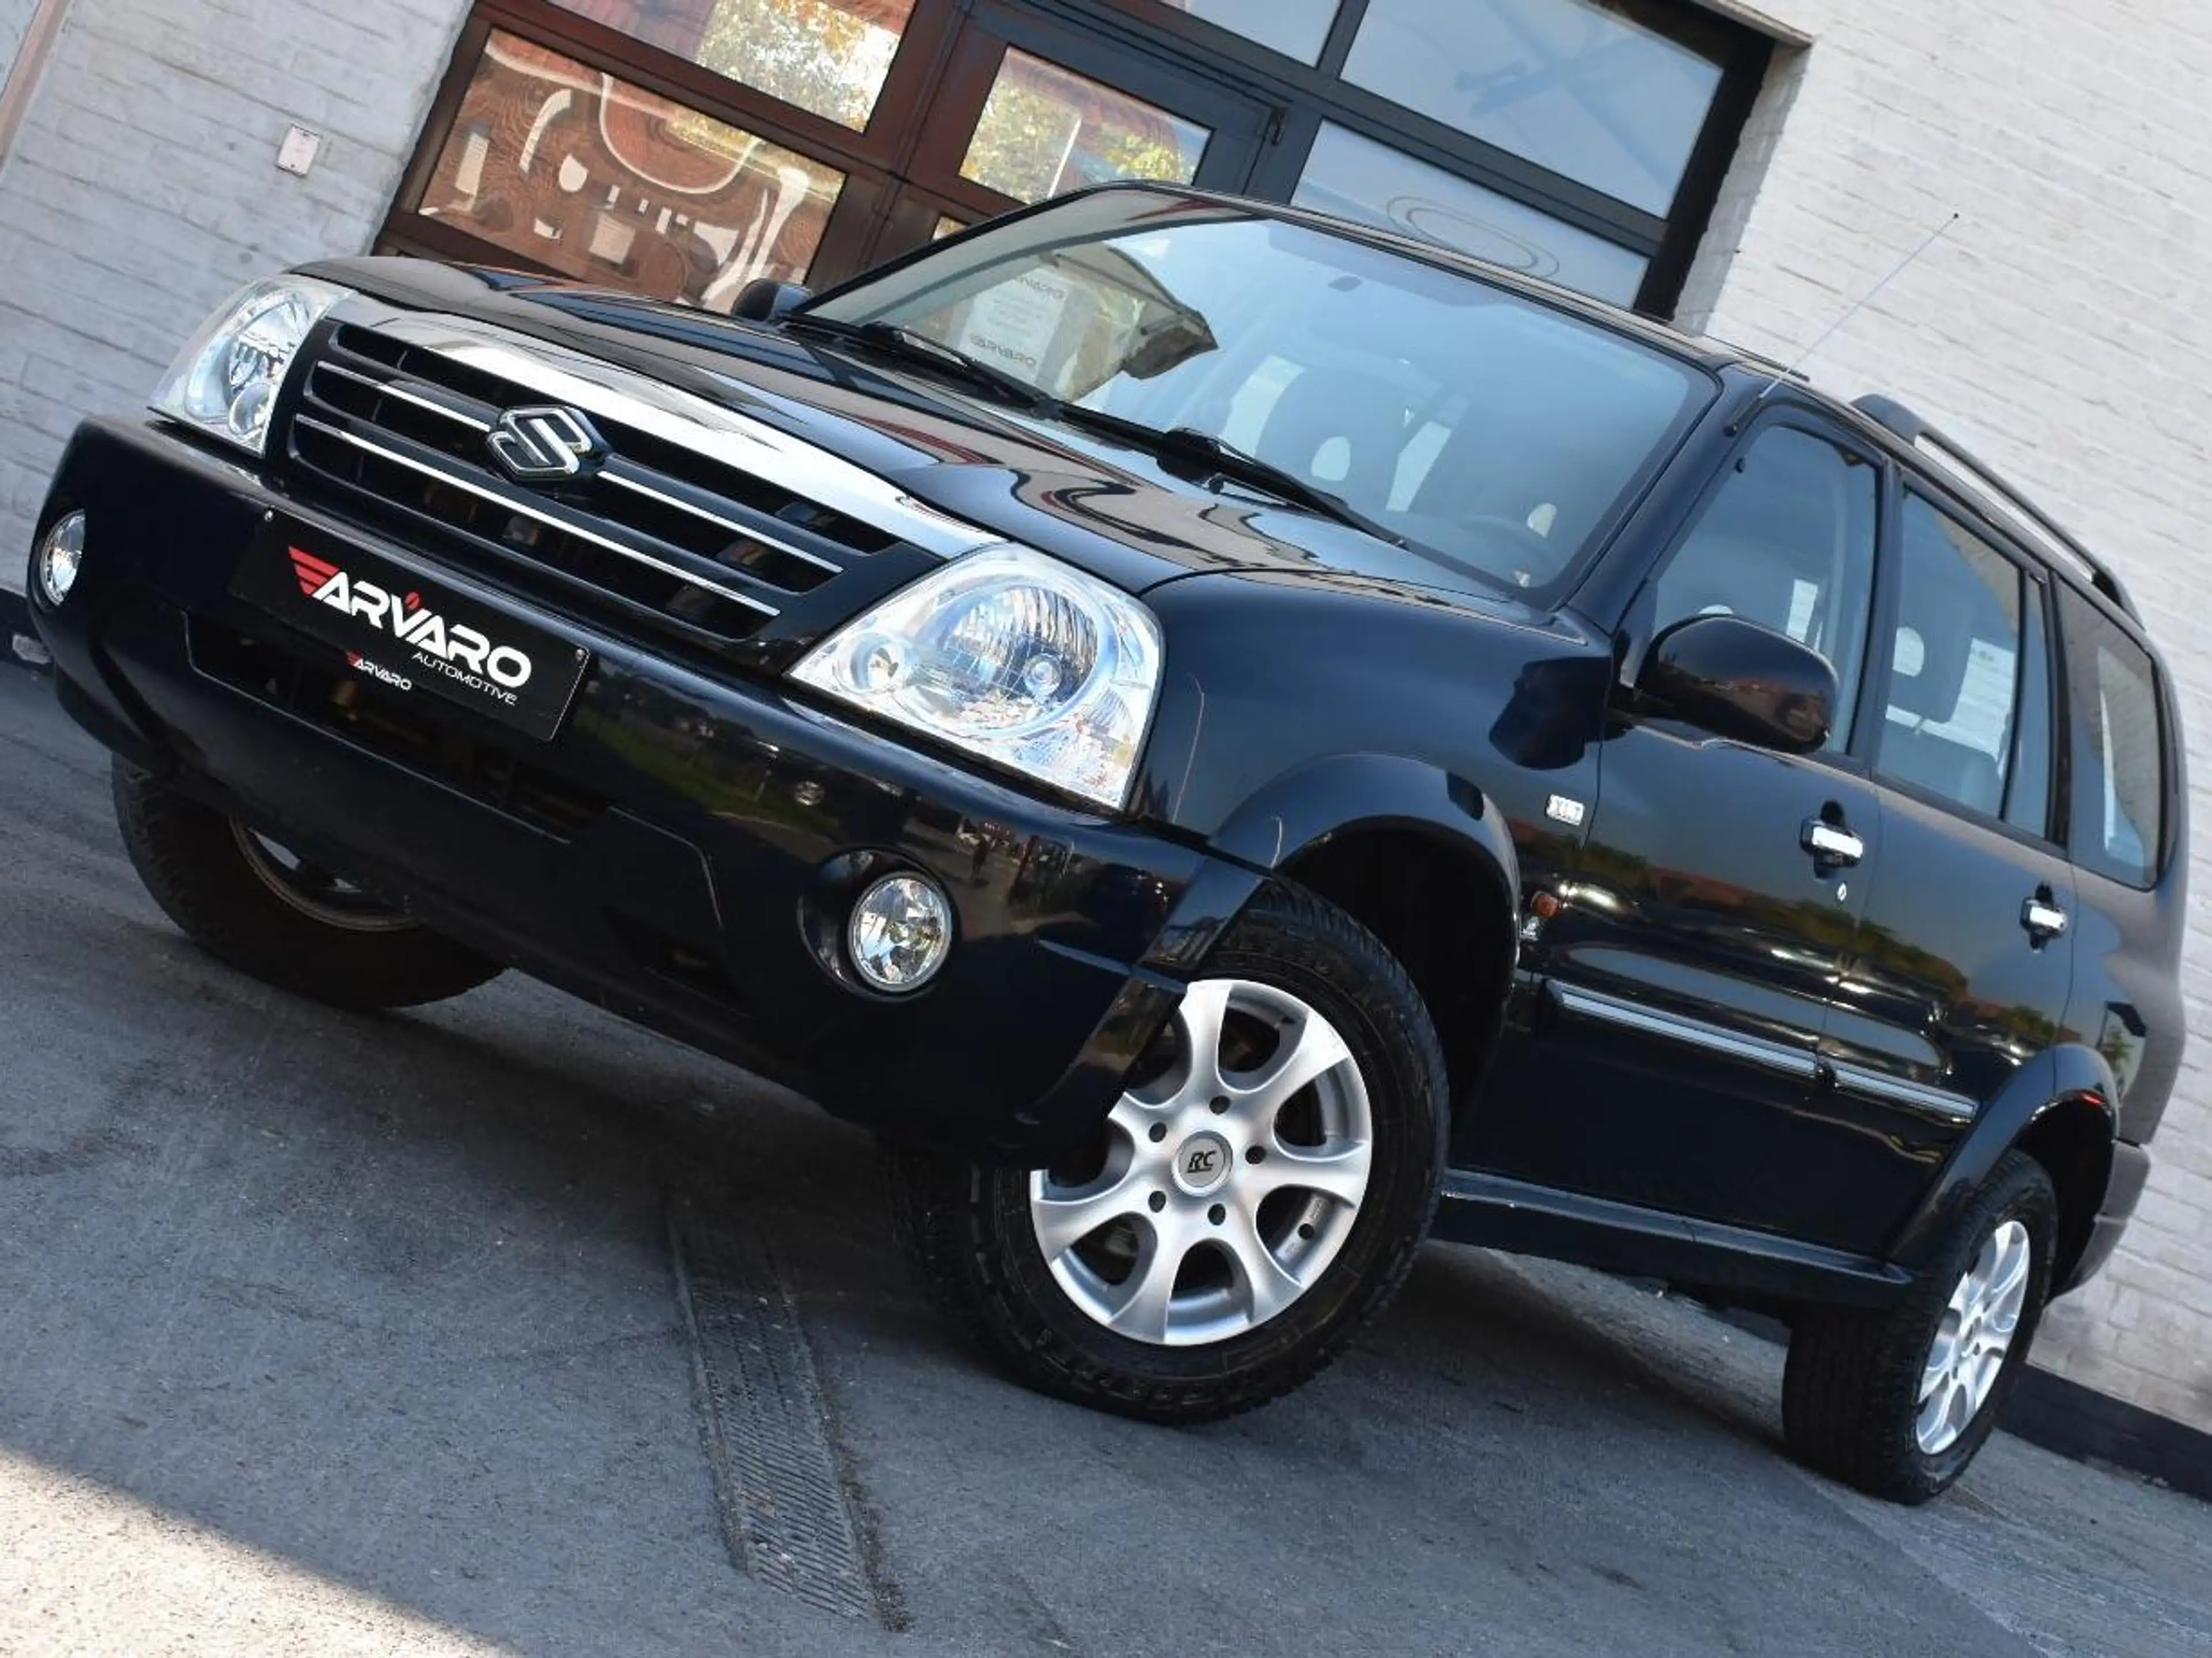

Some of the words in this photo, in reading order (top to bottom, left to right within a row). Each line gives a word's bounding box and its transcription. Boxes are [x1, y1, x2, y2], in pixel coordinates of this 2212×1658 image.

[312, 571, 532, 688] ARVARO
[354, 658, 412, 691] ARVARO
[412, 651, 518, 706] AUTOMOTIVE
[1187, 1150, 1217, 1173] RC
